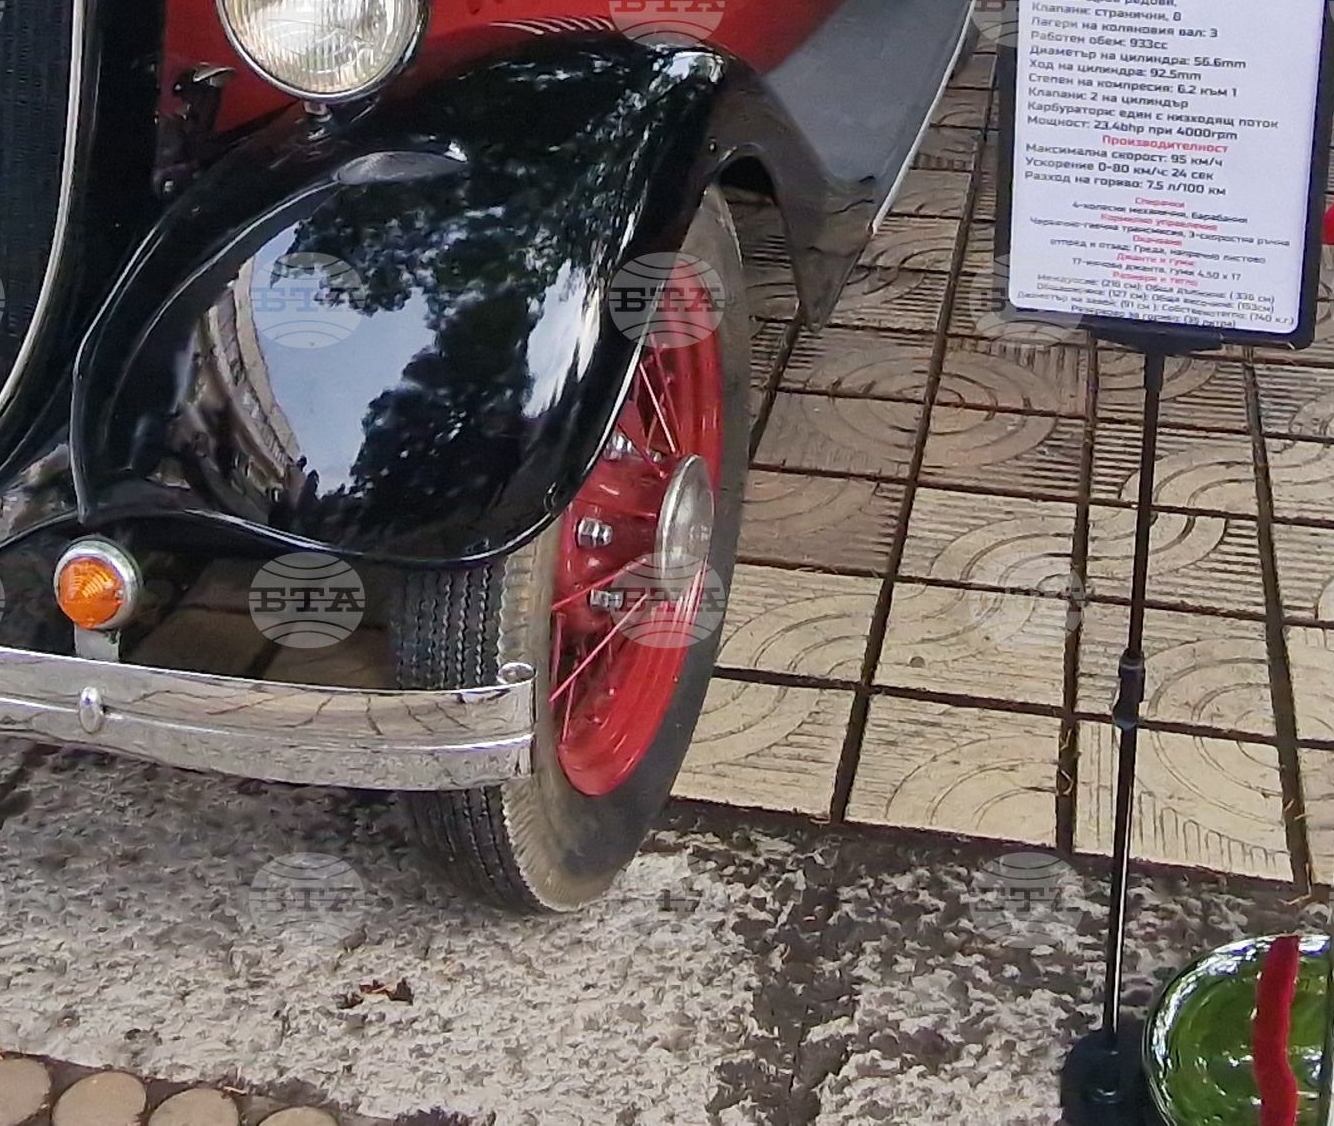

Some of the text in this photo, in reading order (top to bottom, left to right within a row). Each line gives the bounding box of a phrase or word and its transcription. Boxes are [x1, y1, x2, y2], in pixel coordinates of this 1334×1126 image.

[1031, 16, 1078, 29] Лагери
[1082, 22, 1097, 30] на
[1179, 28, 1206, 37] вал:
[1209, 28, 1218, 37] 3
[1031, 31, 1085, 43] Работен
[1029, 45, 1096, 60] Диаметър
[1100, 51, 1116, 60] на
[1120, 53, 1190, 66] цилиндра:
[1029, 59, 1054, 70] Ход
[1058, 62, 1073, 70] на
[1028, 73, 1073, 85] Степен
[1077, 77, 1093, 86] на
[1200, 88, 1227, 96] към
[1232, 88, 1237, 97] 1
[1090, 92, 1098, 101] 2
[1102, 94, 1117, 103] на
[1121, 96, 1188, 109] цилиндър
[1119, 109, 1152, 120] един
[1167, 113, 1234, 127] низходящ
[1239, 118, 1279, 129] поток
[1148, 126, 1173, 136] при
[1176, 127, 1238, 140] 4000rpm
[1102, 134, 1229, 153] Производителност
[1026, 143, 1107, 158] Максимална
[1191, 157, 1223, 166] км/ч
[1025, 156, 1094, 171] Ускорение
[1171, 168, 1187, 178] 24
[1191, 171, 1214, 180] сек
[1025, 171, 1071, 184] Разход
[1075, 176, 1090, 184] на
[1167, 182, 1204, 194] л/100
[1208, 187, 1226, 195] км
